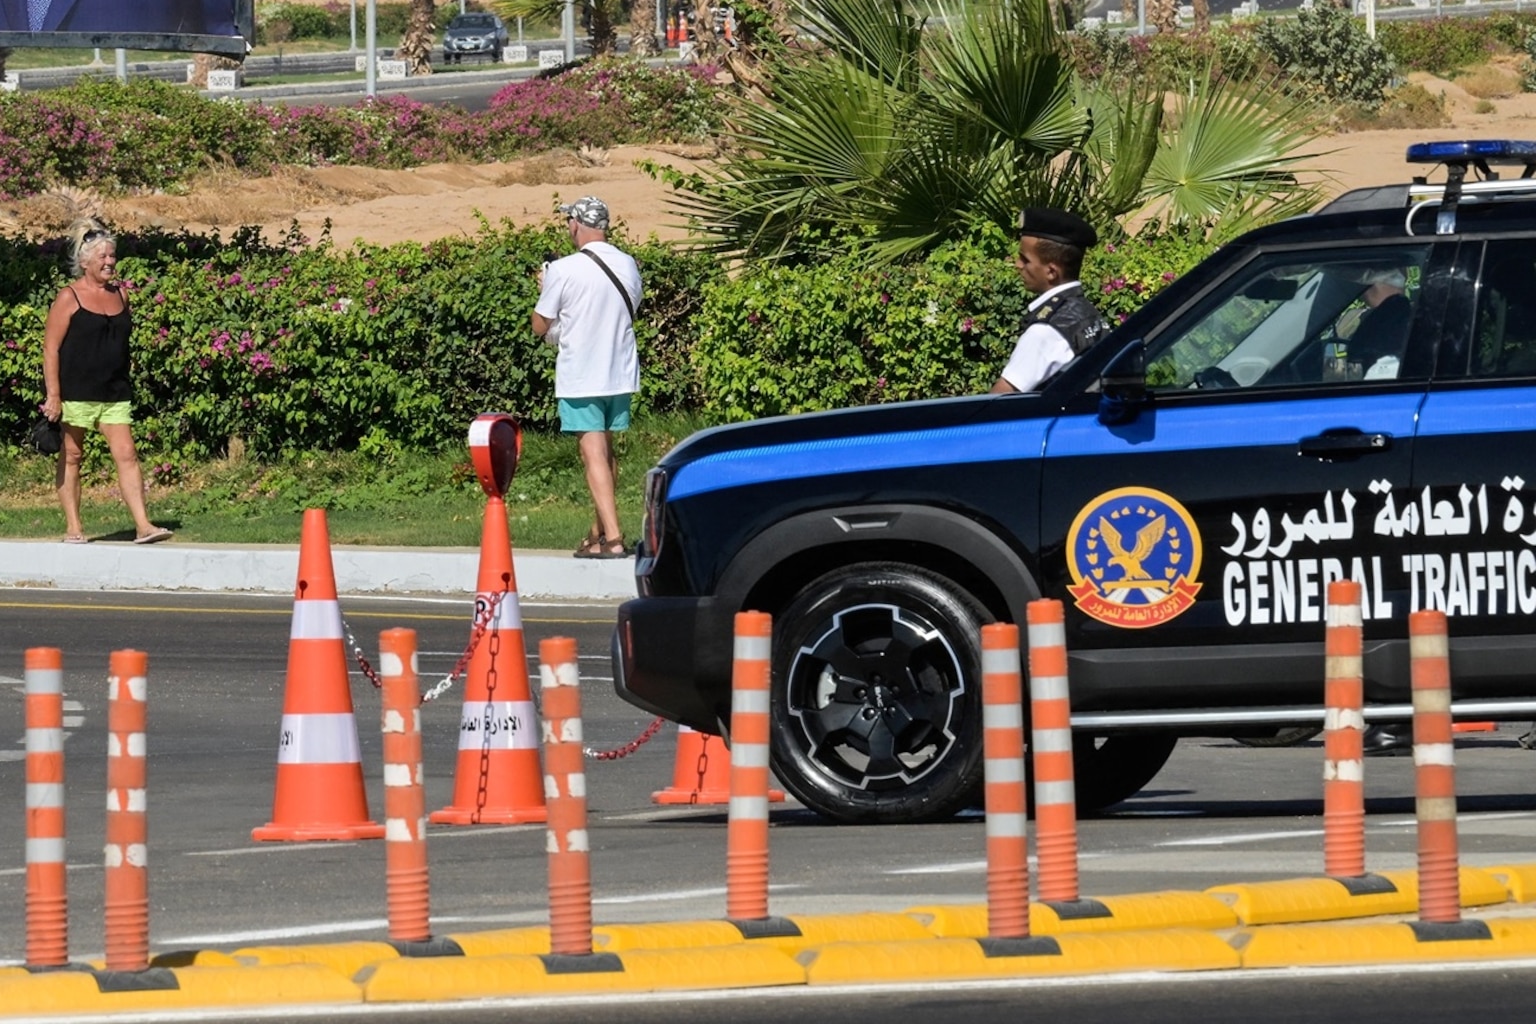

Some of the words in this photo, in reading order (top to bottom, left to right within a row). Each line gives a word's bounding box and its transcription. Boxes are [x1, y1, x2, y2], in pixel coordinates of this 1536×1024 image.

[1368, 478, 1488, 537] العامة
[1220, 488, 1356, 558] للمرور
[1402, 549, 1536, 618] TRAFFIC
[1088, 602, 1123, 620] للمرور
[1123, 606, 1152, 622] العامة
[1152, 596, 1182, 620] الإدارة
[484, 716, 522, 736] الإدارة
